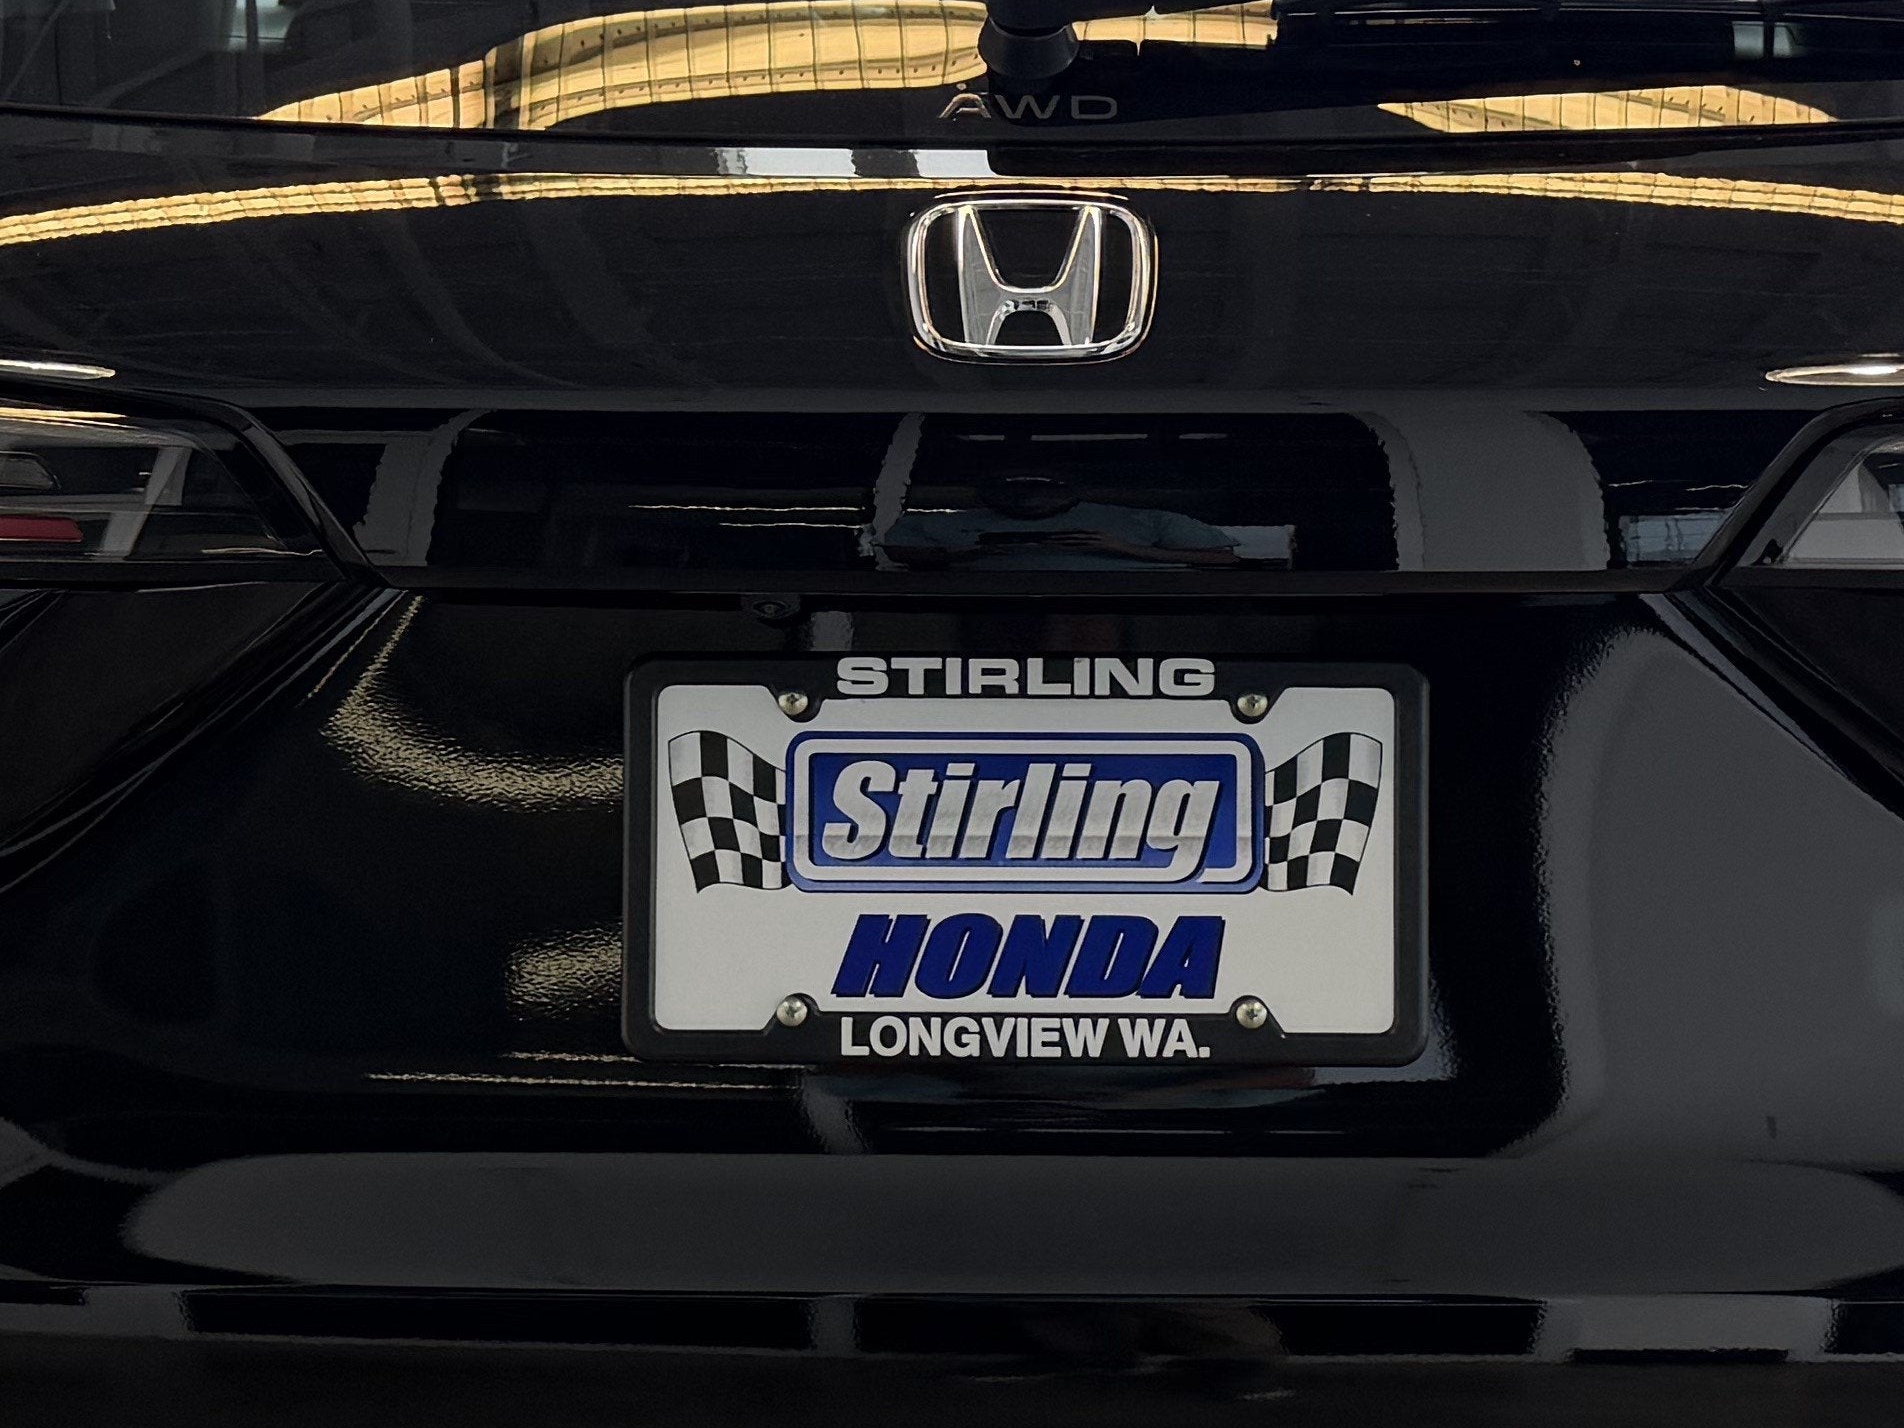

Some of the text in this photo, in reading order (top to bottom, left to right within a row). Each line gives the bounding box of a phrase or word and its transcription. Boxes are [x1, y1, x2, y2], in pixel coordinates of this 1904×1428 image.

[938, 93, 1118, 120] AWD
[836, 657, 1215, 697] STIRLING
[821, 760, 1220, 884] Stirling
[829, 914, 1224, 999] HONDA
[840, 1016, 1211, 1058] LONGVIEW WA.
